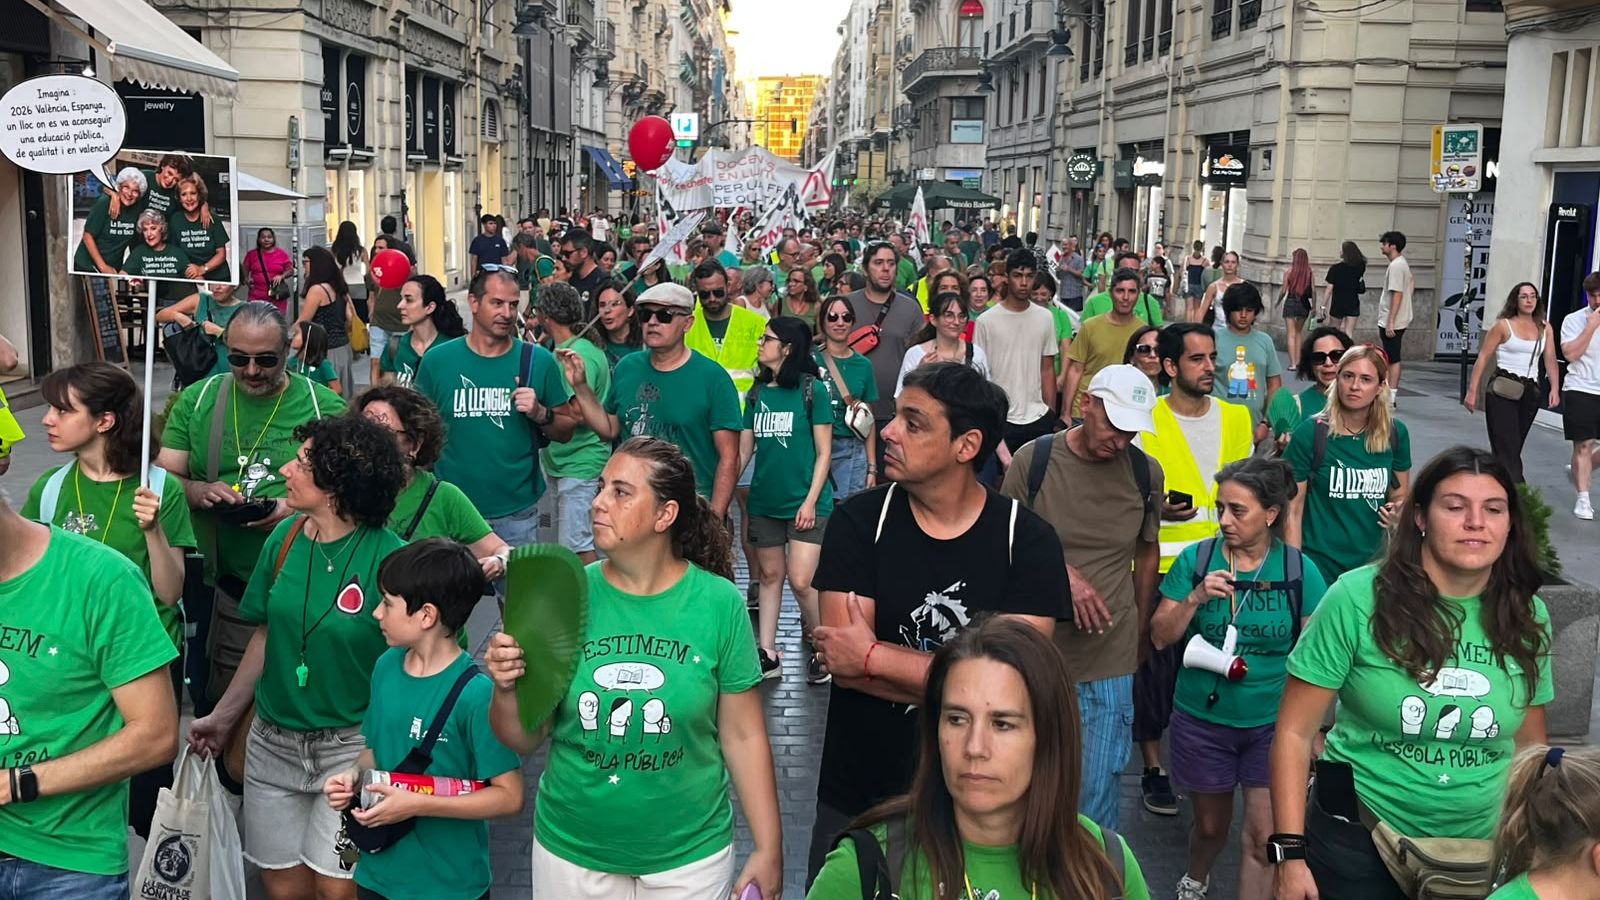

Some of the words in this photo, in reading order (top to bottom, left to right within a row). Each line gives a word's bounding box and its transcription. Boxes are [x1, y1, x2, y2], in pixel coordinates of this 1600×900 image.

[38, 88, 70, 101] Imagina
[10, 106, 32, 116] 2026
[72, 102, 106, 114] Espanya,
[144, 101, 174, 111] jewelry
[20, 120, 34, 130] lloc
[72, 115, 112, 128] aconseguir
[38, 132, 70, 142] educació
[16, 148, 26, 158] de
[29, 146, 58, 160] qualitat
[80, 144, 110, 154] valencià
[714, 183, 743, 193] PER
[713, 196, 732, 204] DE
[1558, 206, 1576, 217] Revolut
[454, 388, 466, 412] LA
[468, 387, 511, 411] LLENGUA
[754, 413, 762, 432] LA
[762, 412, 794, 432] LLENGUA
[1330, 466, 1344, 492] LA
[1346, 468, 1388, 494] LLENGUA
[581, 634, 691, 665] ESTIMEM
